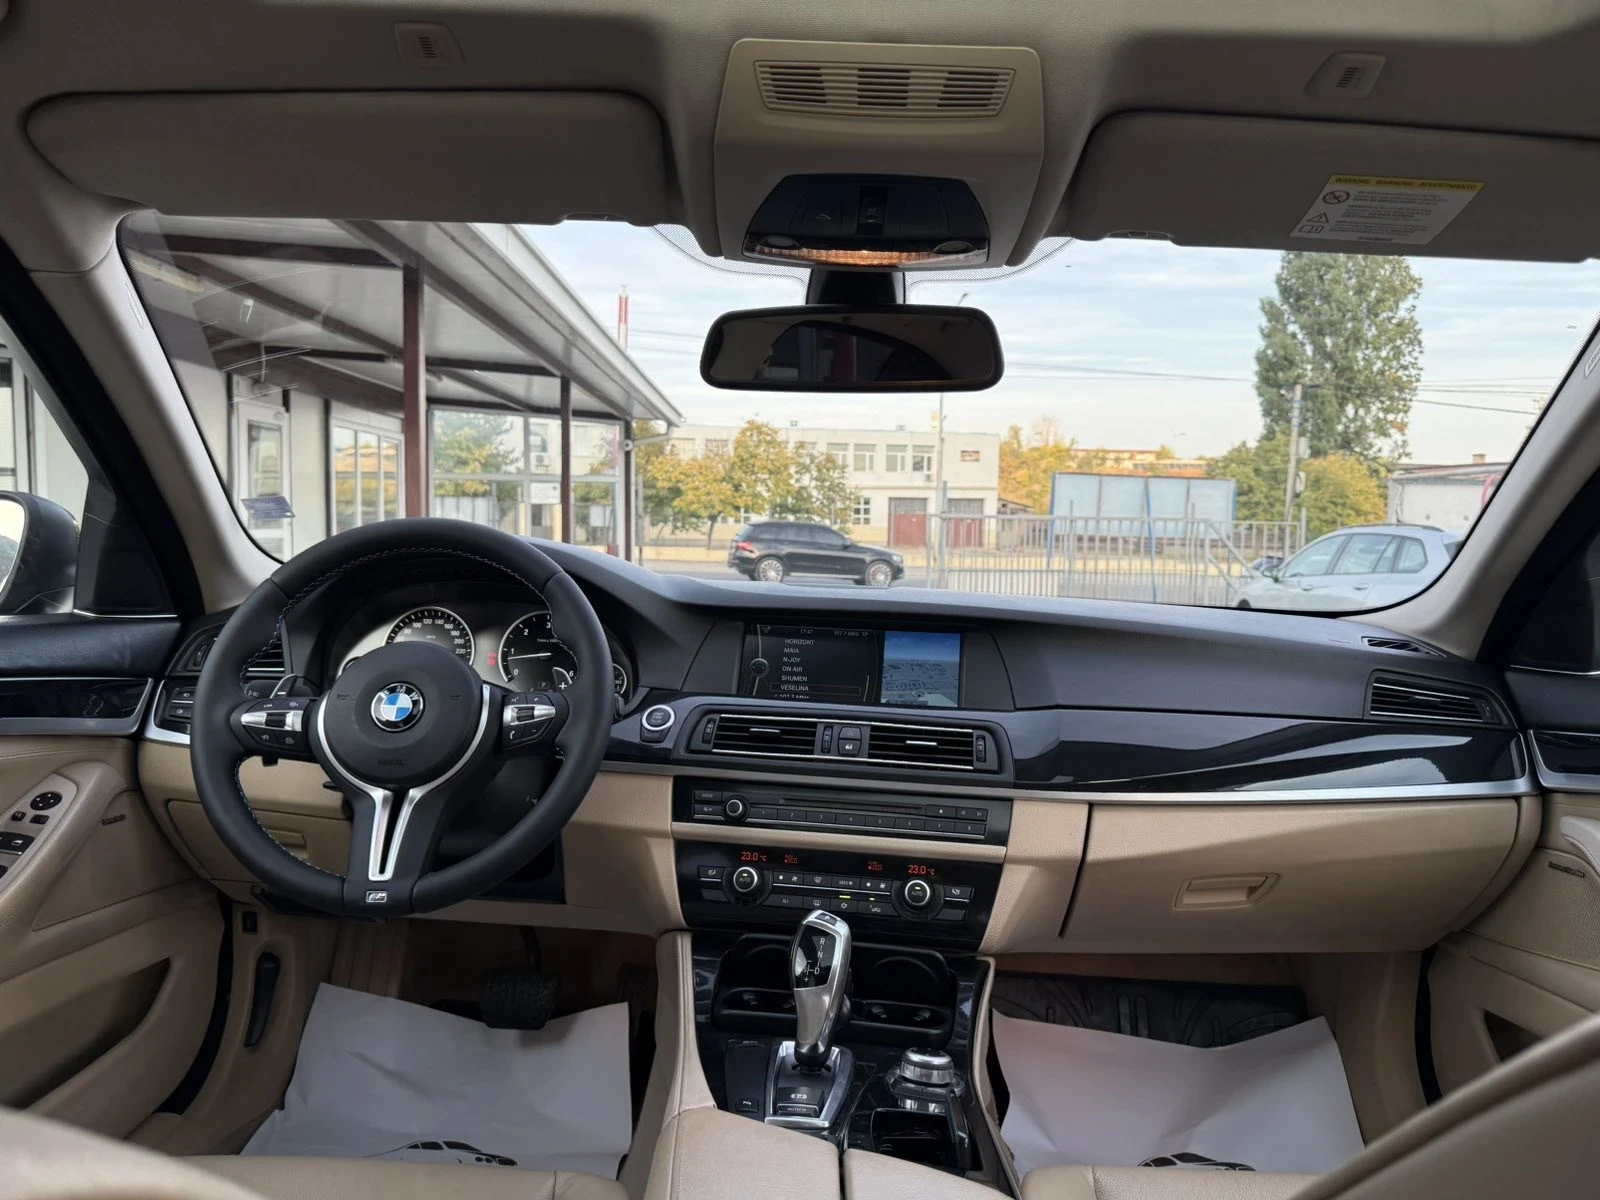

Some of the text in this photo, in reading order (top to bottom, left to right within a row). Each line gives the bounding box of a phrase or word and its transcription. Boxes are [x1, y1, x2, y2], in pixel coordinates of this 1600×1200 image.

[523, 628, 529, 636] 2
[513, 668, 519, 676] 0
[741, 851, 758, 861] 23.0
[908, 864, 925, 874] 23.0
[820, 937, 826, 945] R
[817, 951, 824, 959] N
[814, 967, 820, 975] D
